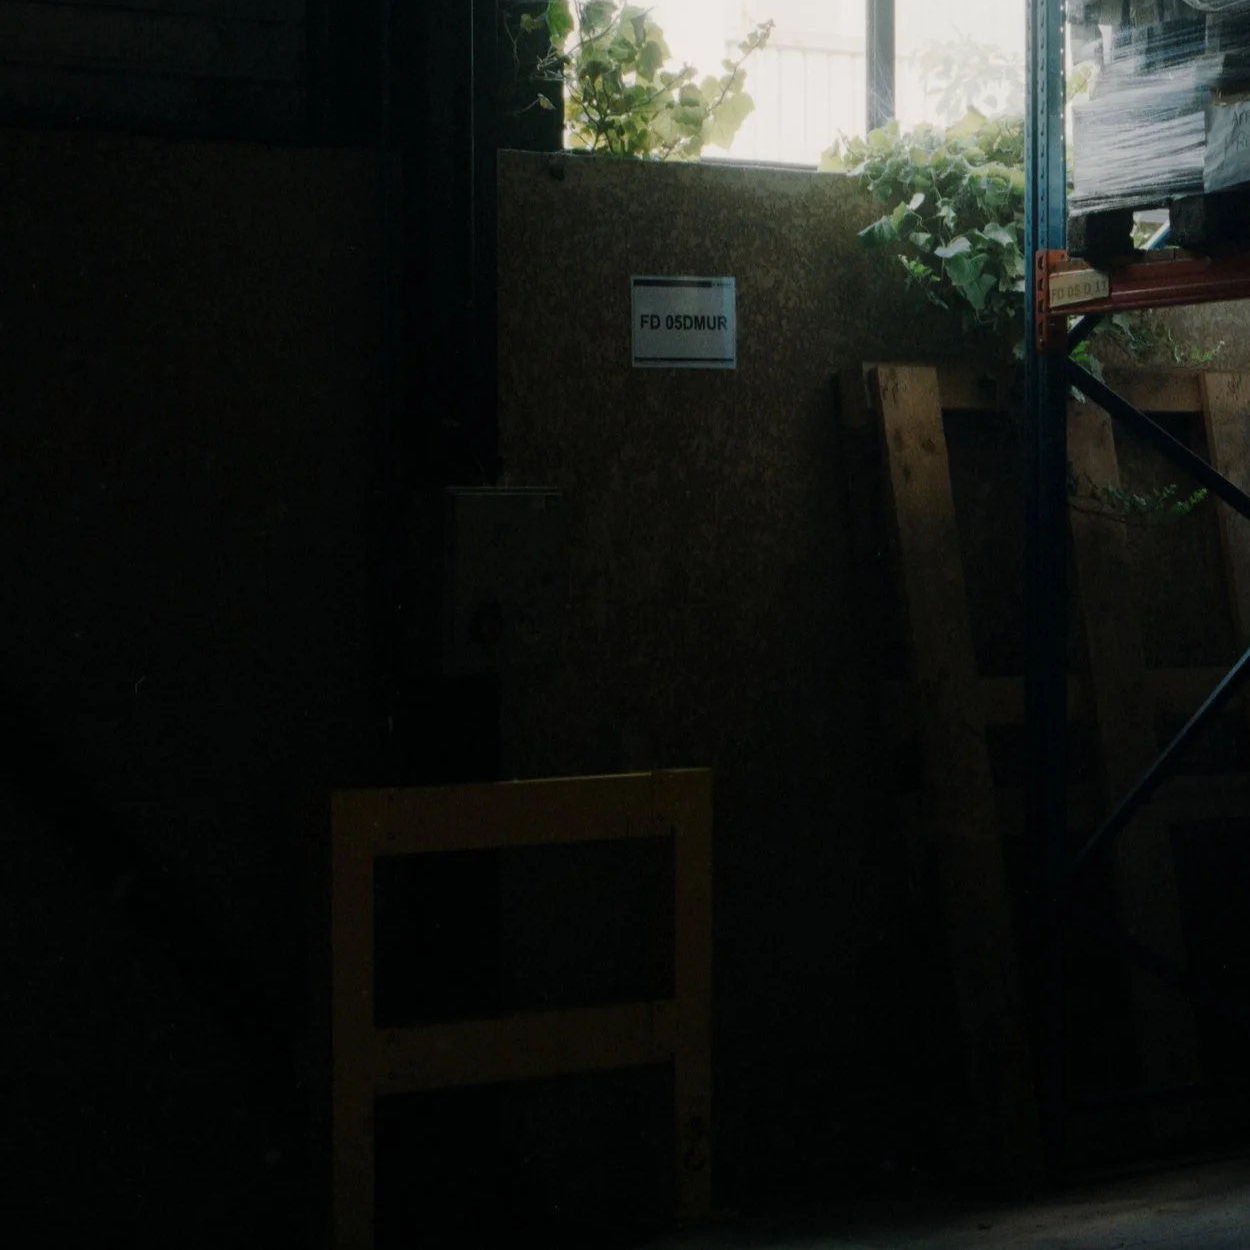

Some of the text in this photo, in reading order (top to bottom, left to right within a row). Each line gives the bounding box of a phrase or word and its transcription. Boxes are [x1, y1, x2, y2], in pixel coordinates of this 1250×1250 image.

[1052, 286, 1065, 301] FD
[1068, 283, 1081, 298] 05
[1083, 282, 1092, 295] D
[640, 314, 728, 331] FD 05DMUR
